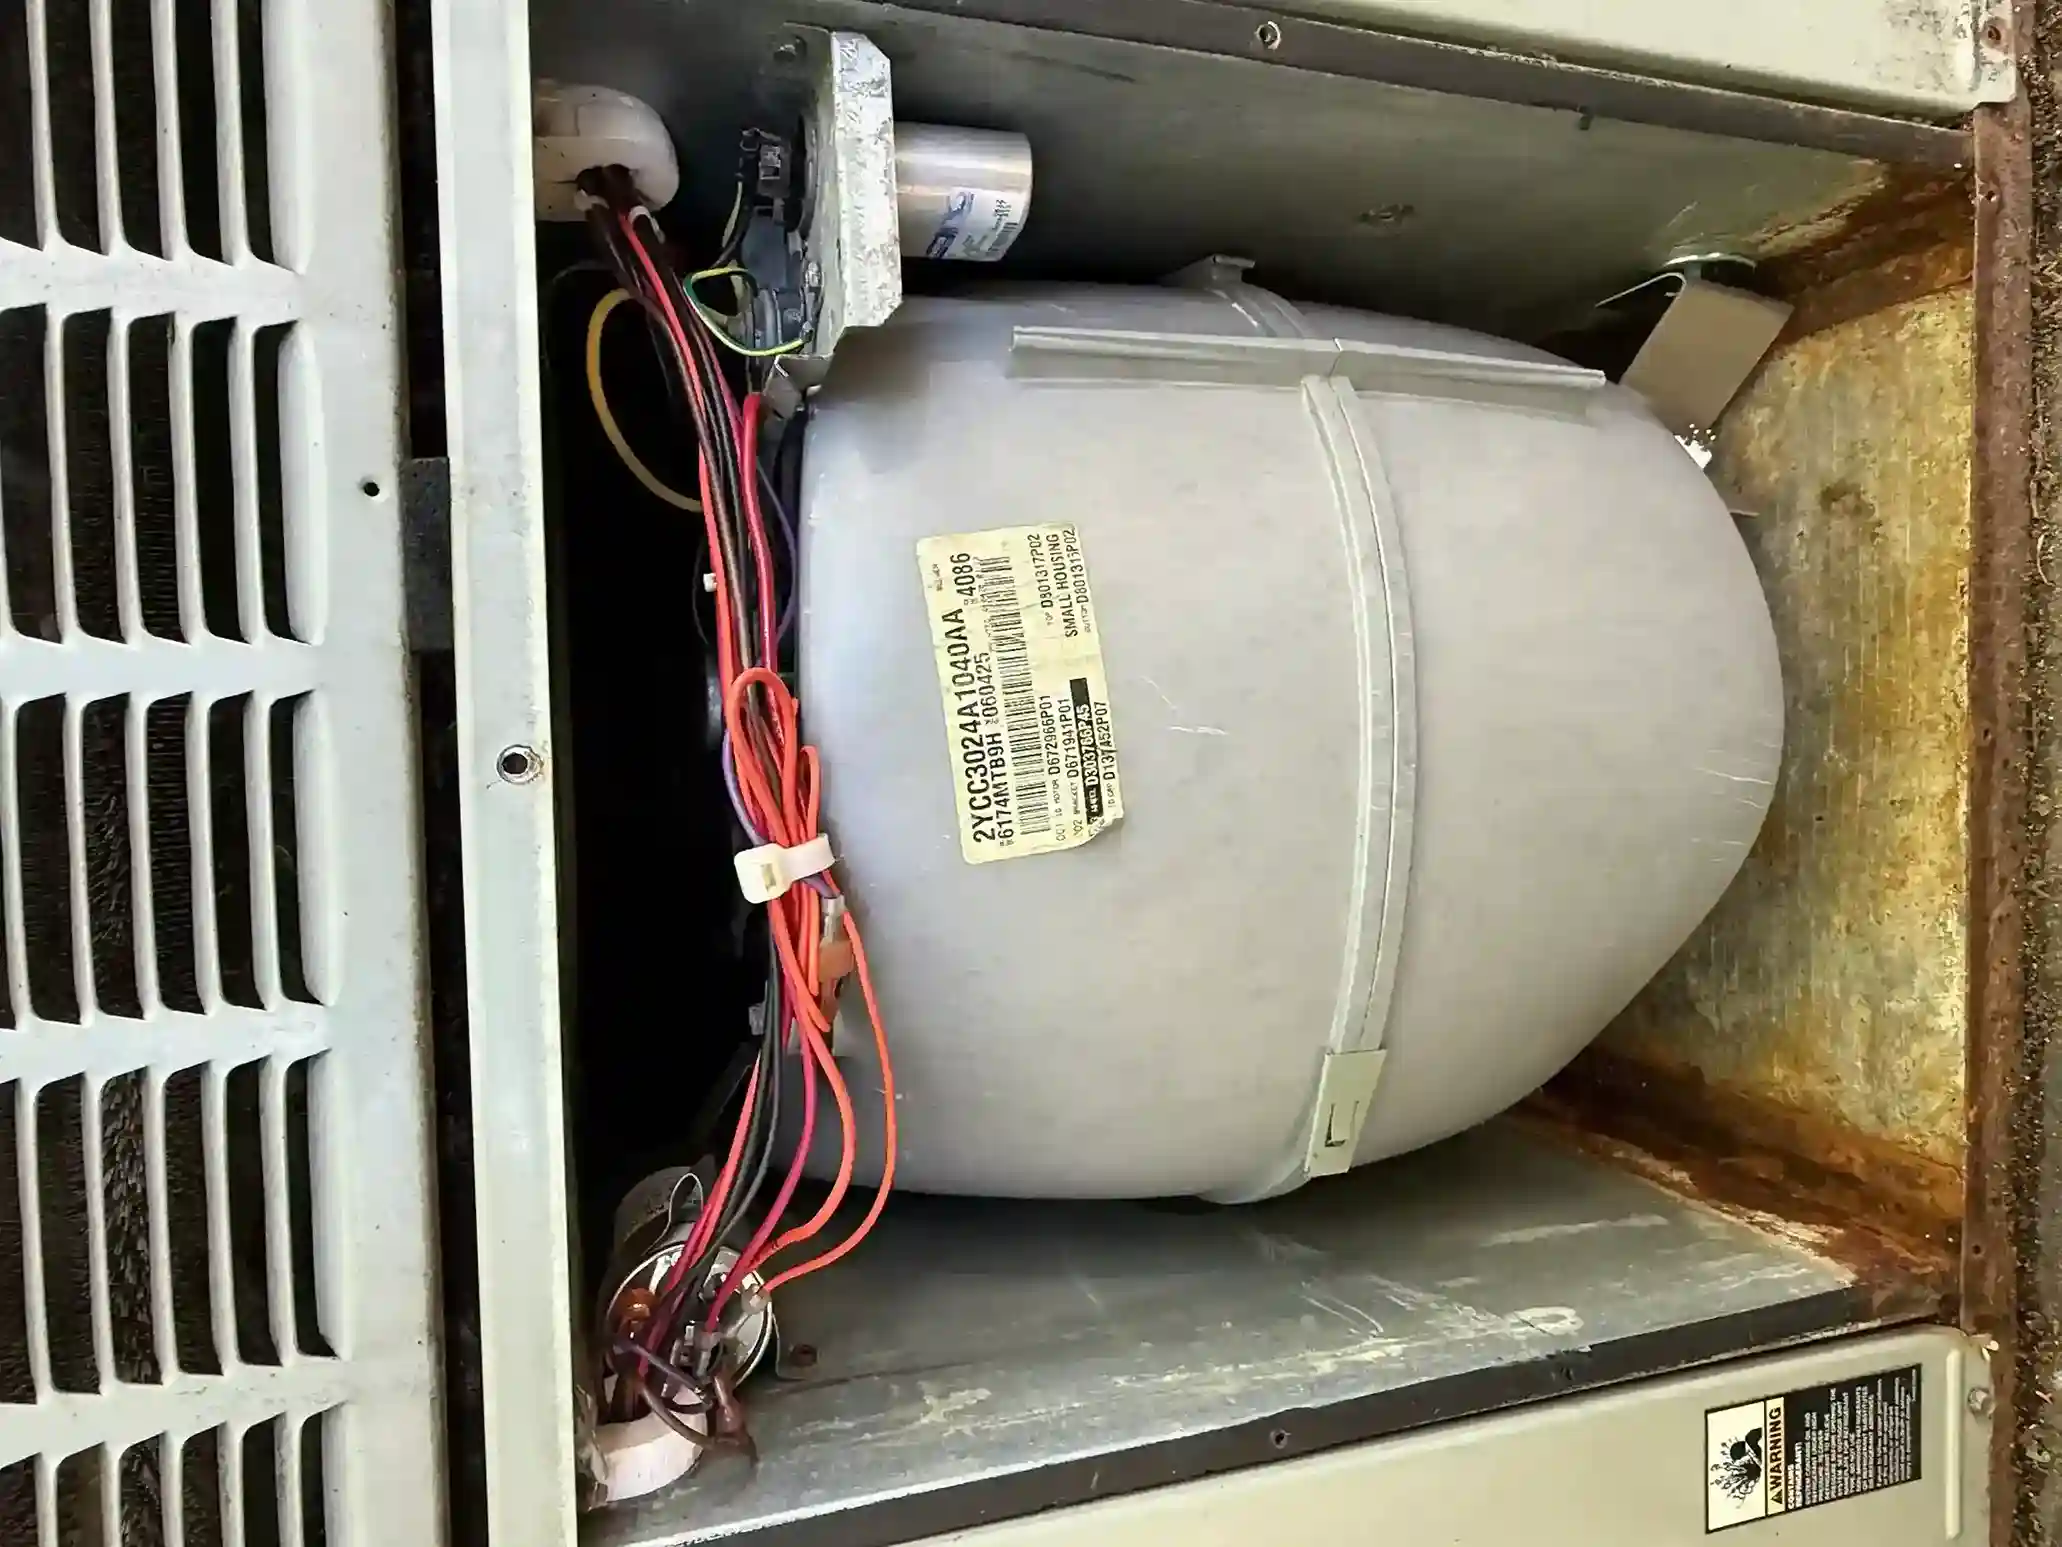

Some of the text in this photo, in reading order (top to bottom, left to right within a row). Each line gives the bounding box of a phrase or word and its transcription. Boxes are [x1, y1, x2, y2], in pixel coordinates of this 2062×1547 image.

[951, 552, 977, 597] 4086
[1046, 534, 1078, 637] SMALL HOUSING
[941, 608, 995, 842] 2YCC3024A1040AA
[974, 653, 998, 717] 060425
[1040, 695, 1061, 775] D672966P01
[1058, 698, 1078, 777] D671941P01
[989, 733, 1014, 838] 6174MTB9H
[1768, 1406, 1782, 1491] WARNING
